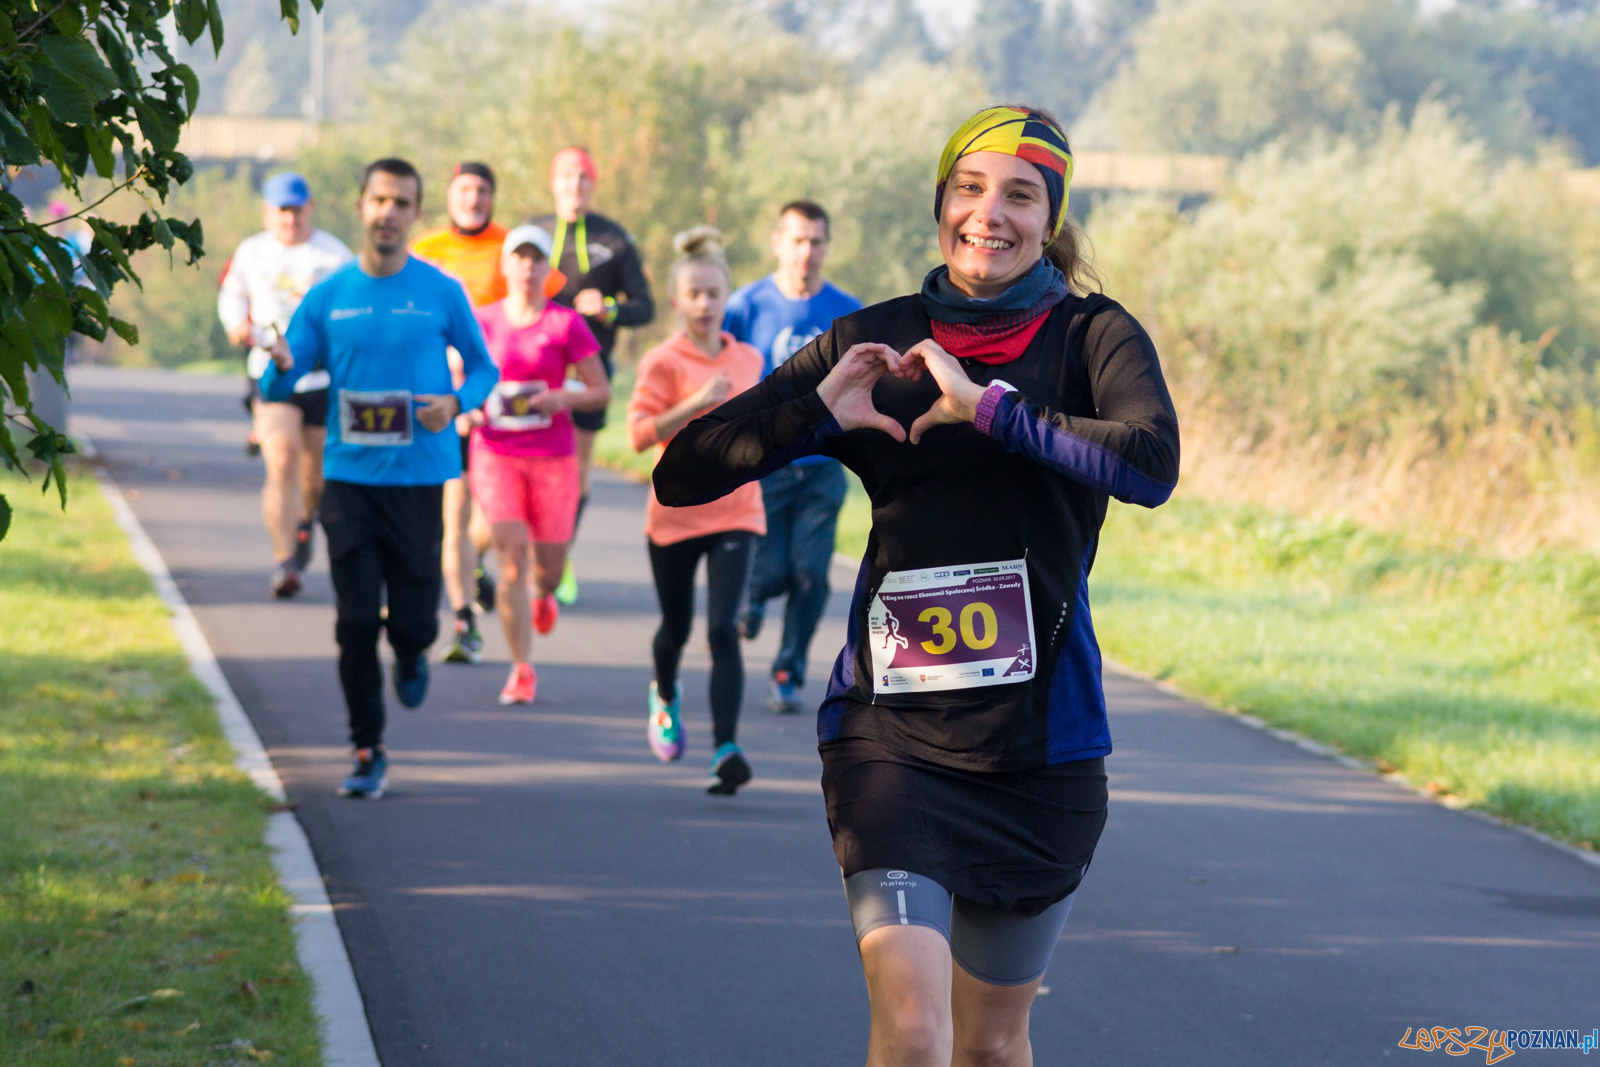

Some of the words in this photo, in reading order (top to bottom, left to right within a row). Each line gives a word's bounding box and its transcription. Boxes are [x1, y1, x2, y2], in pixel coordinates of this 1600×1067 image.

[360, 407, 397, 431] 17
[945, 586, 975, 595] Społecznej
[976, 584, 996, 592] Śródka
[999, 581, 1021, 589] Zawady
[918, 602, 998, 655] 30
[880, 880, 916, 888] Kalenji
